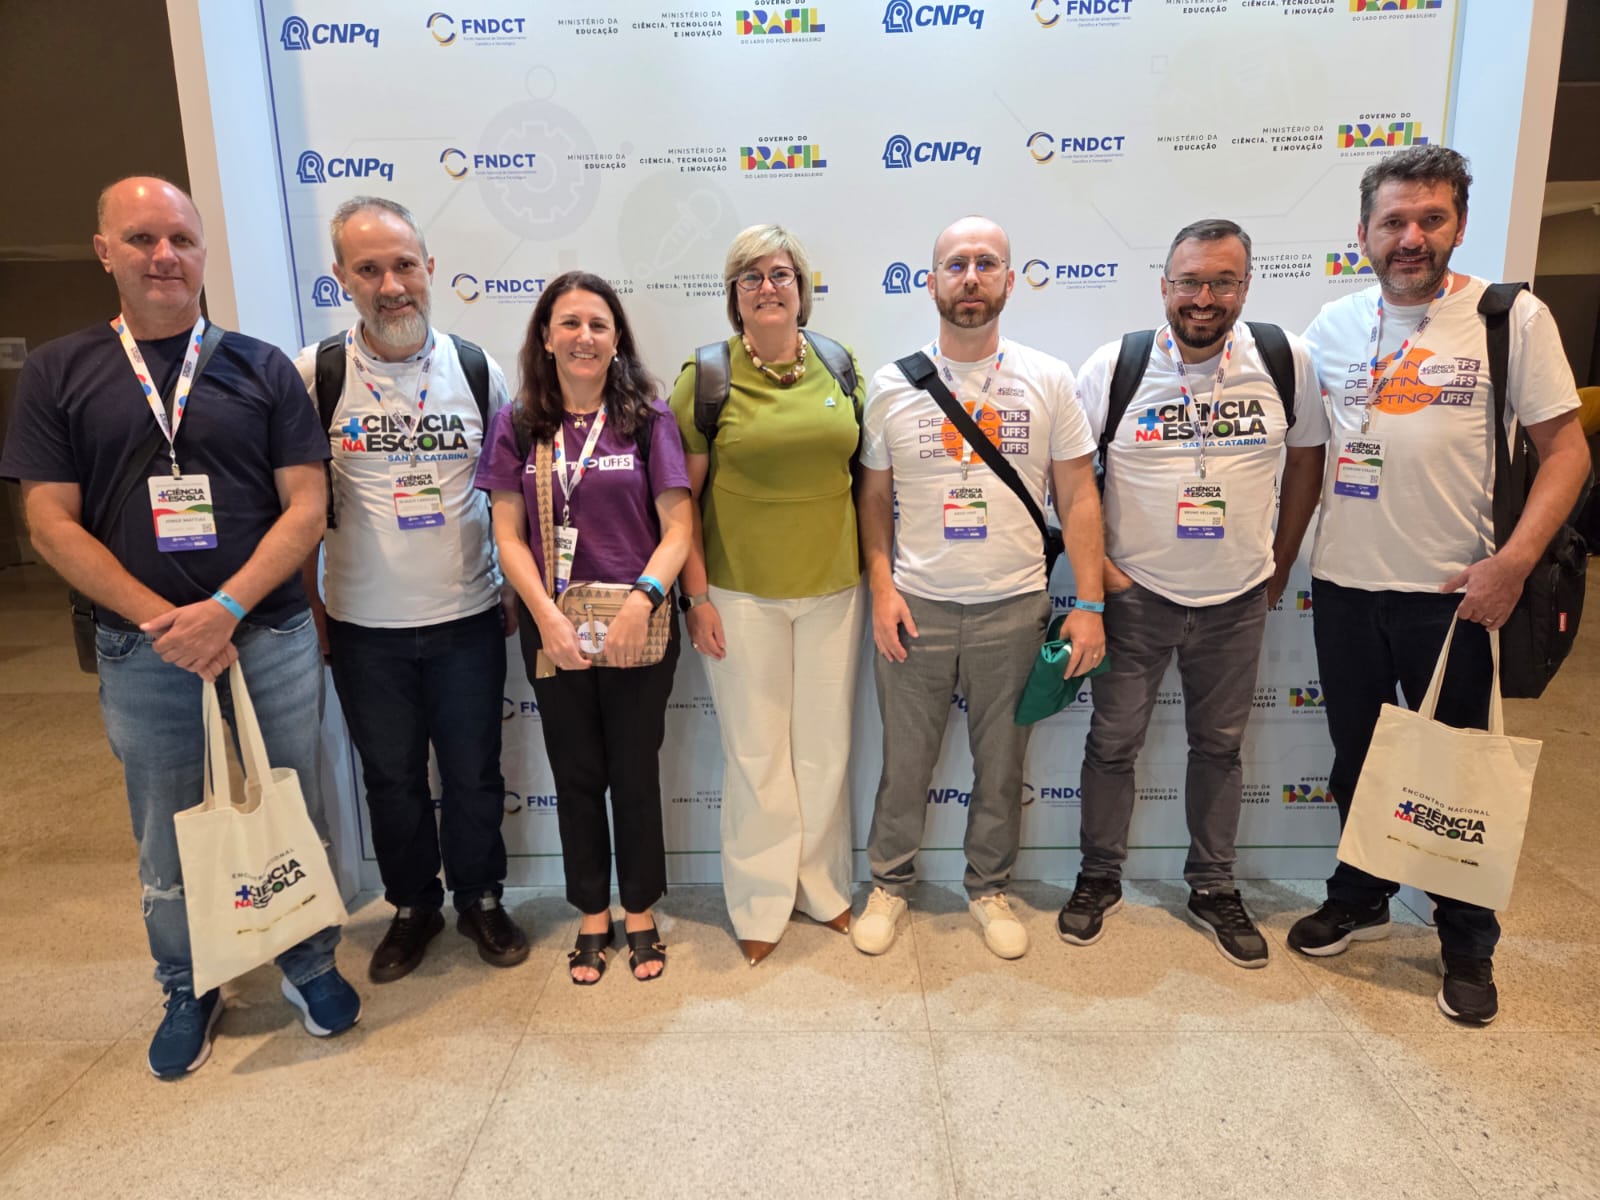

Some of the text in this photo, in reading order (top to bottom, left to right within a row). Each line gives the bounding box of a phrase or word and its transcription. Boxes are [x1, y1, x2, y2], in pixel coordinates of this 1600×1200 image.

[1066, 0, 1133, 15] FNDCT
[1183, 5, 1227, 14] EDUCAÇÃO
[1291, 7, 1334, 15] INOVAÇÃO
[661, 11, 708, 19] MINISTÉRIO
[915, 4, 985, 30] CNPq
[461, 18, 526, 34] FNDCT
[558, 18, 605, 26] MINISTÉRIO
[670, 20, 722, 28] TECNOLOGIA
[735, 8, 826, 36] BRASIL
[312, 23, 380, 48] CNPq
[575, 27, 619, 36] EDUCAÇÃO
[681, 30, 723, 38] INOVAÇÃO
[1359, 112, 1397, 120] GOVERNO
[1262, 126, 1311, 134] MINISTÉRIO
[758, 135, 794, 143] GOVERNO
[1157, 134, 1204, 142] MINISTÉRIO
[1271, 135, 1323, 143] TECNOLOGIA
[1336, 122, 1429, 149] BRASIL
[1061, 136, 1125, 152] FNDCT
[1173, 143, 1217, 151] EDUCAÇÃO
[1280, 143, 1323, 152] INOVAÇÃO
[668, 147, 714, 155] MINISTÉRIO
[914, 141, 982, 165] CNPq
[473, 153, 536, 169] FNDCT
[567, 153, 613, 161] MINISTÉRIO
[677, 156, 727, 164] TECNOLOGIA
[739, 143, 827, 171] BRASIL
[327, 157, 394, 182] CNPq
[584, 162, 626, 170] EDUCAÇÃO
[687, 165, 727, 173] INOVAÇÃO
[1325, 252, 1376, 276] BRA
[1056, 263, 1119, 278] FNDCT
[1269, 271, 1311, 279] INOVAÇÃO
[674, 273, 719, 281] MINISTÉRIO
[485, 279, 546, 293] FNDCT
[693, 289, 726, 297] INOVAÇÃ
[1440, 393, 1472, 405] UFFS
[1001, 411, 1028, 422] UFFS
[1001, 427, 1027, 437] UFFS
[1136, 430, 1161, 442] NA
[1217, 437, 1267, 447] CATARINA
[1002, 443, 1028, 454] UFFS
[387, 452, 469, 462] SANA CATARINA
[603, 457, 631, 468] UFFS
[926, 788, 972, 808] NPq
[1041, 787, 1082, 799] FNDC
[526, 795, 558, 807] FND
[1402, 786, 1491, 817] ENCONTRO NACIONAL
[1394, 810, 1484, 845] NA ESCOLA
